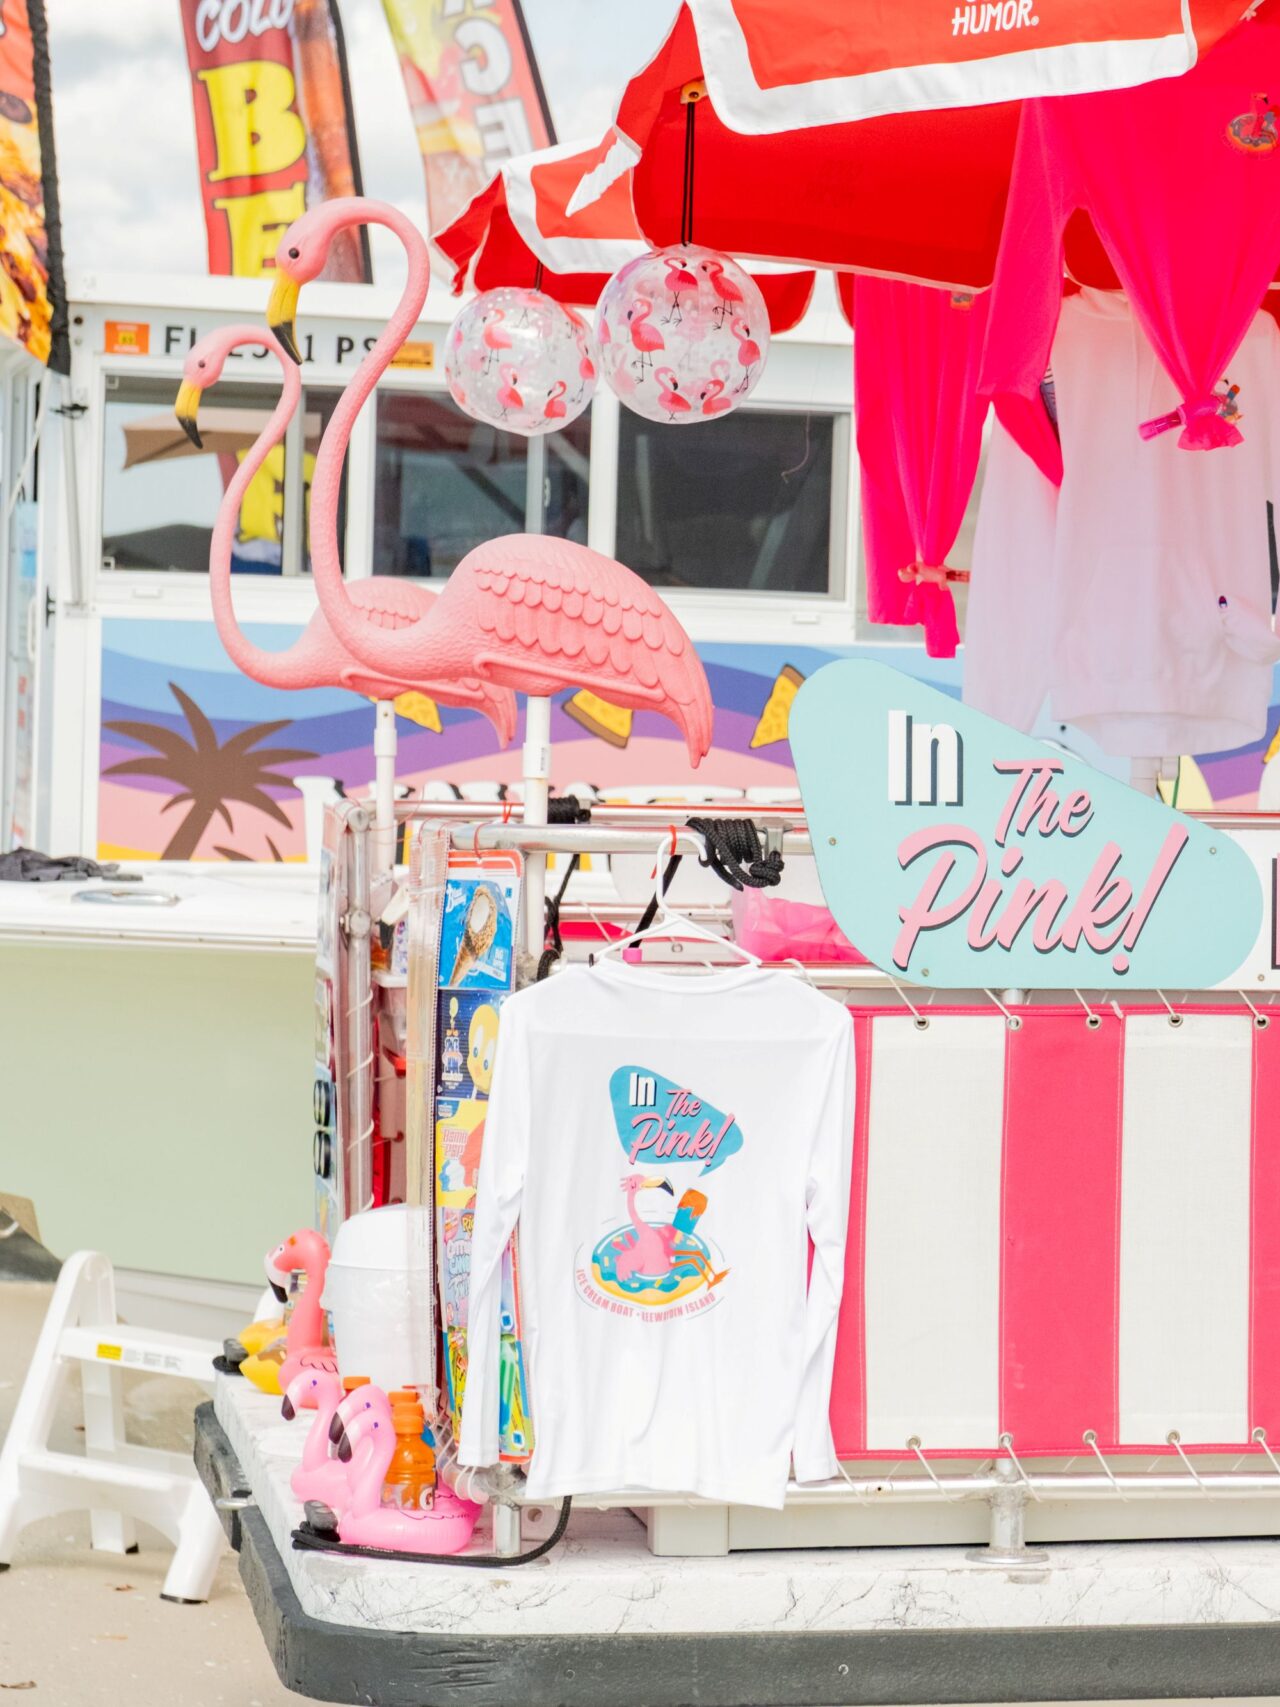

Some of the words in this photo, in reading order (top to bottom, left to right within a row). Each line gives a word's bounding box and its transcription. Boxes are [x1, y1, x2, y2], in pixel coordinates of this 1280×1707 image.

[887, 709, 964, 807] In
[993, 757, 1095, 849] The
[892, 821, 1190, 975] Pink!
[629, 1072, 657, 1107] In
[664, 1088, 702, 1121] The
[628, 1112, 735, 1167] Pink!
[575, 1268, 586, 1288] ICE
[582, 1284, 611, 1310] CREAM
[609, 1302, 634, 1318] BOAT
[685, 1292, 717, 1314] ISLAND
